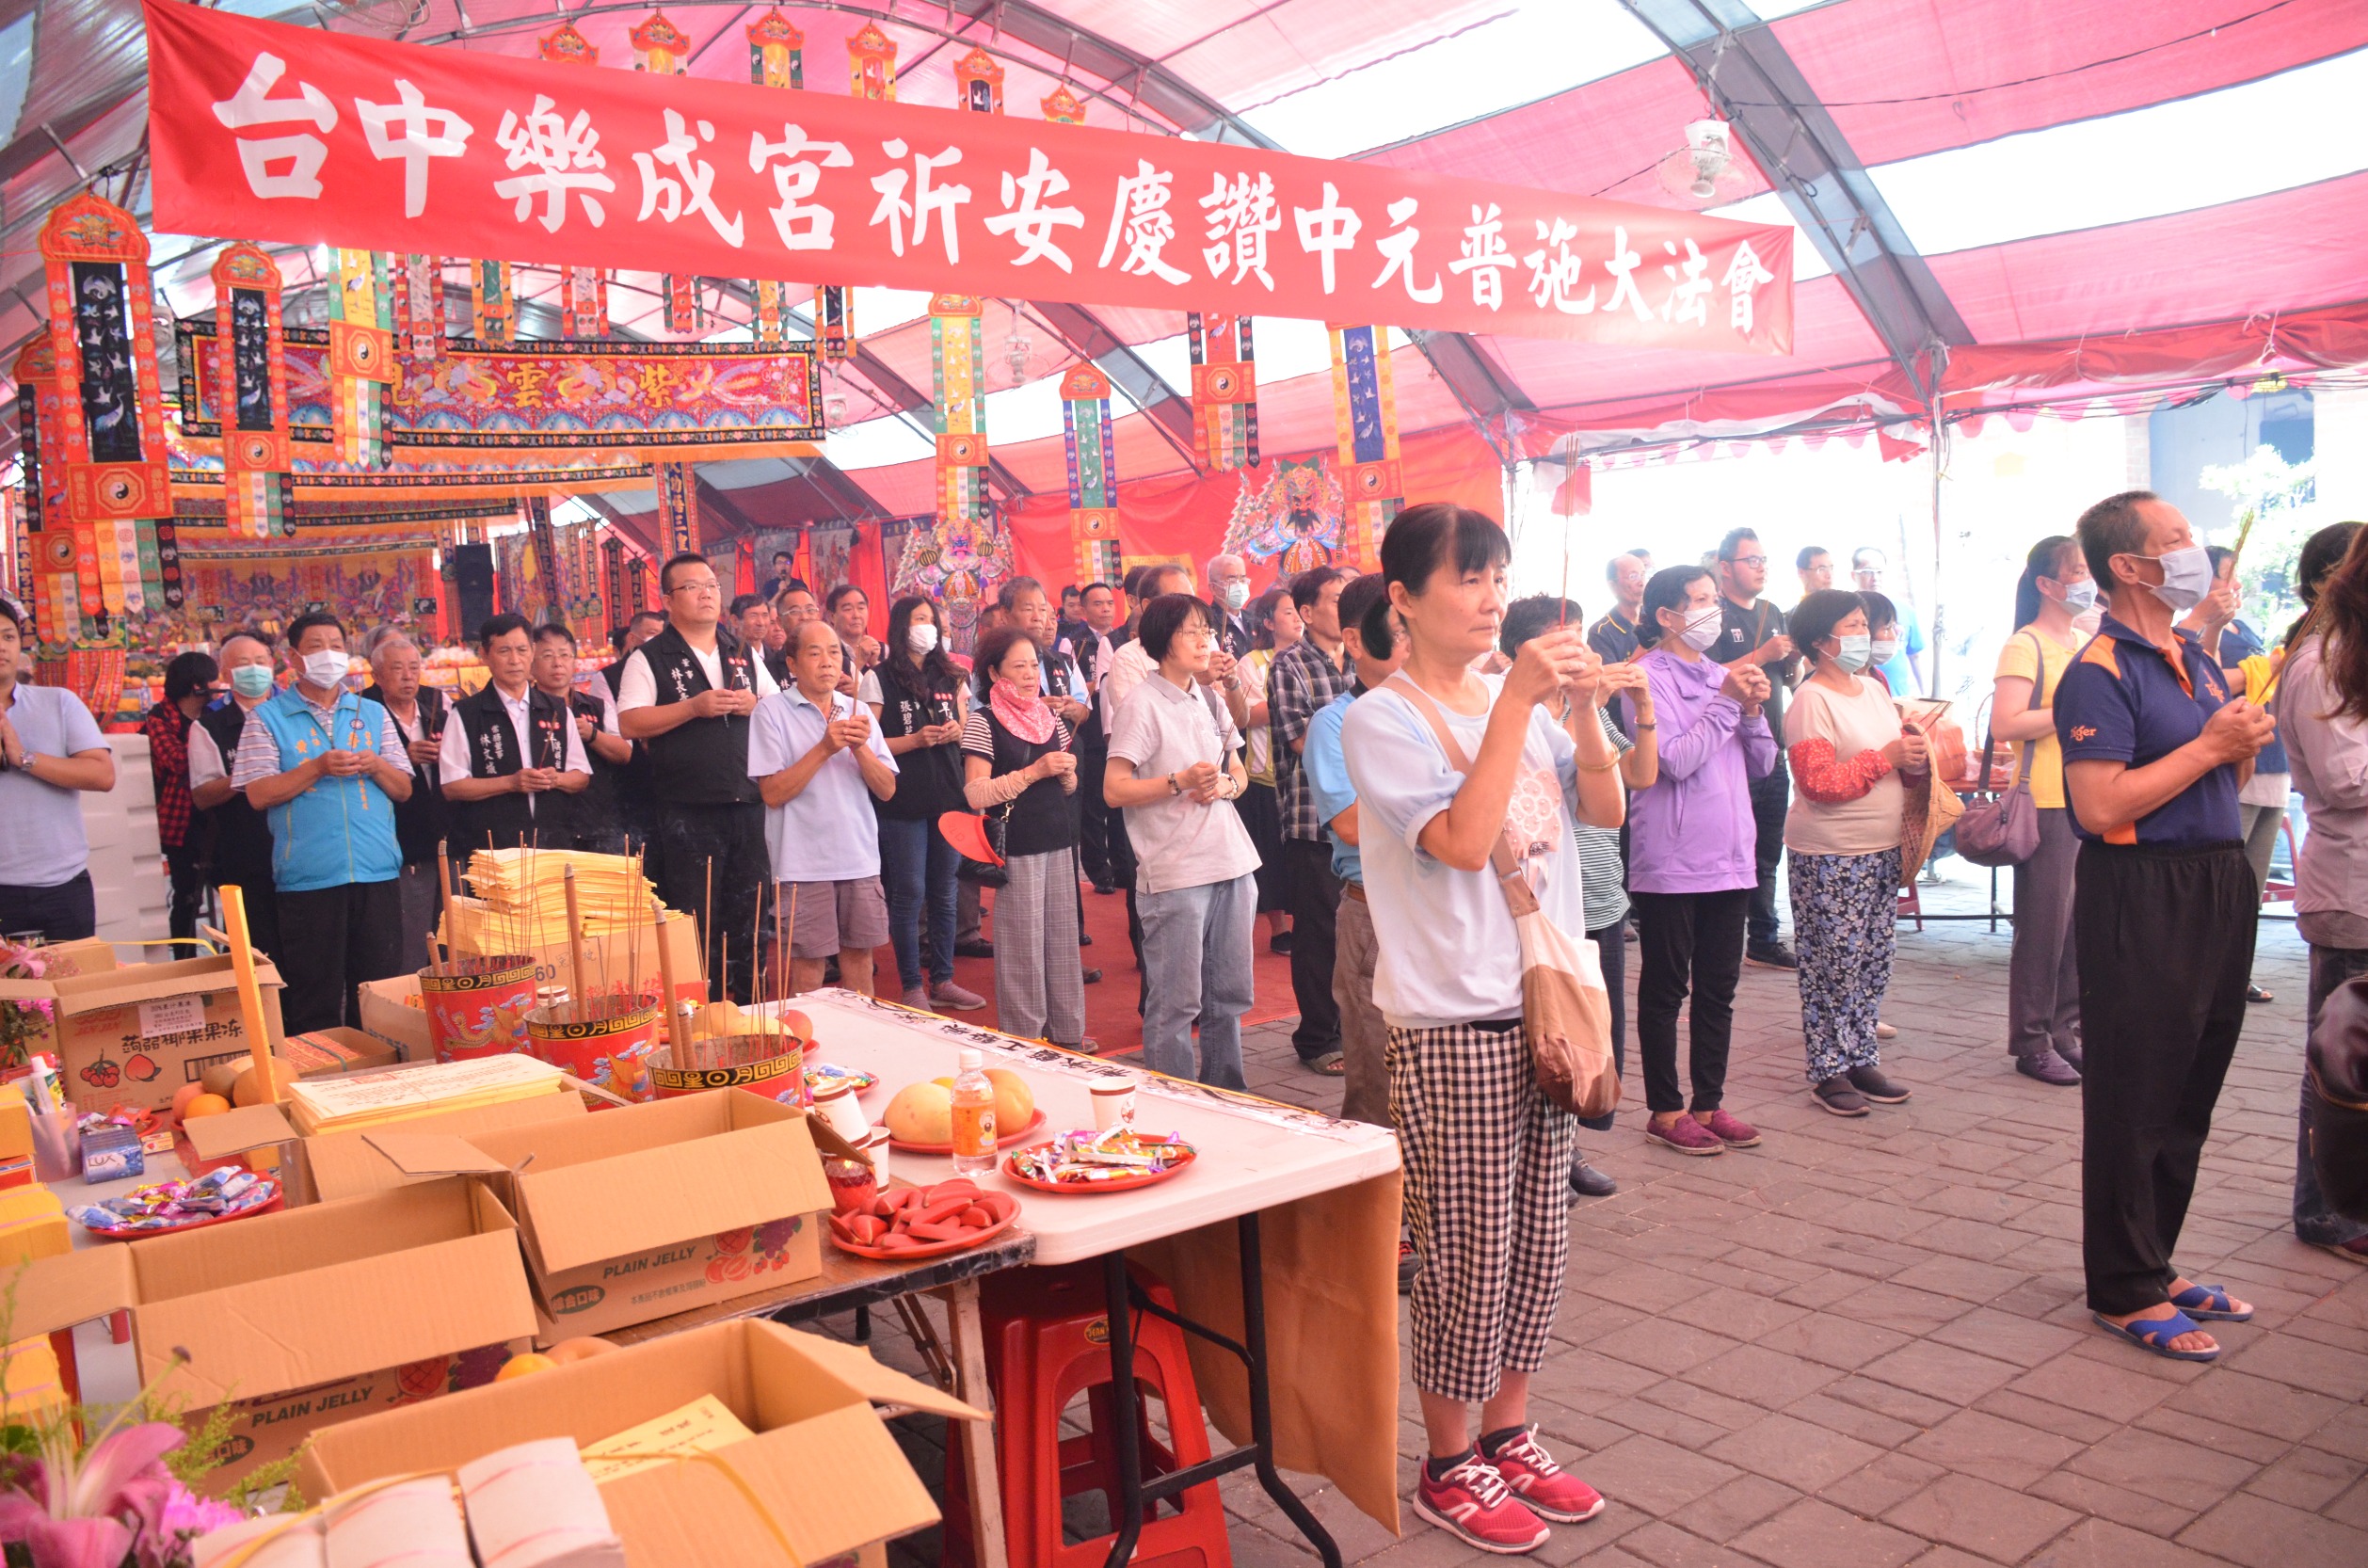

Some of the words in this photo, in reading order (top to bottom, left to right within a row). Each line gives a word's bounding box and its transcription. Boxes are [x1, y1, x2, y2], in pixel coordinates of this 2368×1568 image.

[212, 51, 1776, 335] 台中樂成宮祈安慶讚中元普施大法會
[535, 964, 556, 982] 60
[87, 1154, 117, 1168] LUX
[603, 1257, 648, 1280] PLAIN
[652, 1246, 696, 1268] JELLY
[251, 1400, 311, 1428] PLAIN
[316, 1386, 374, 1413] JELLY
